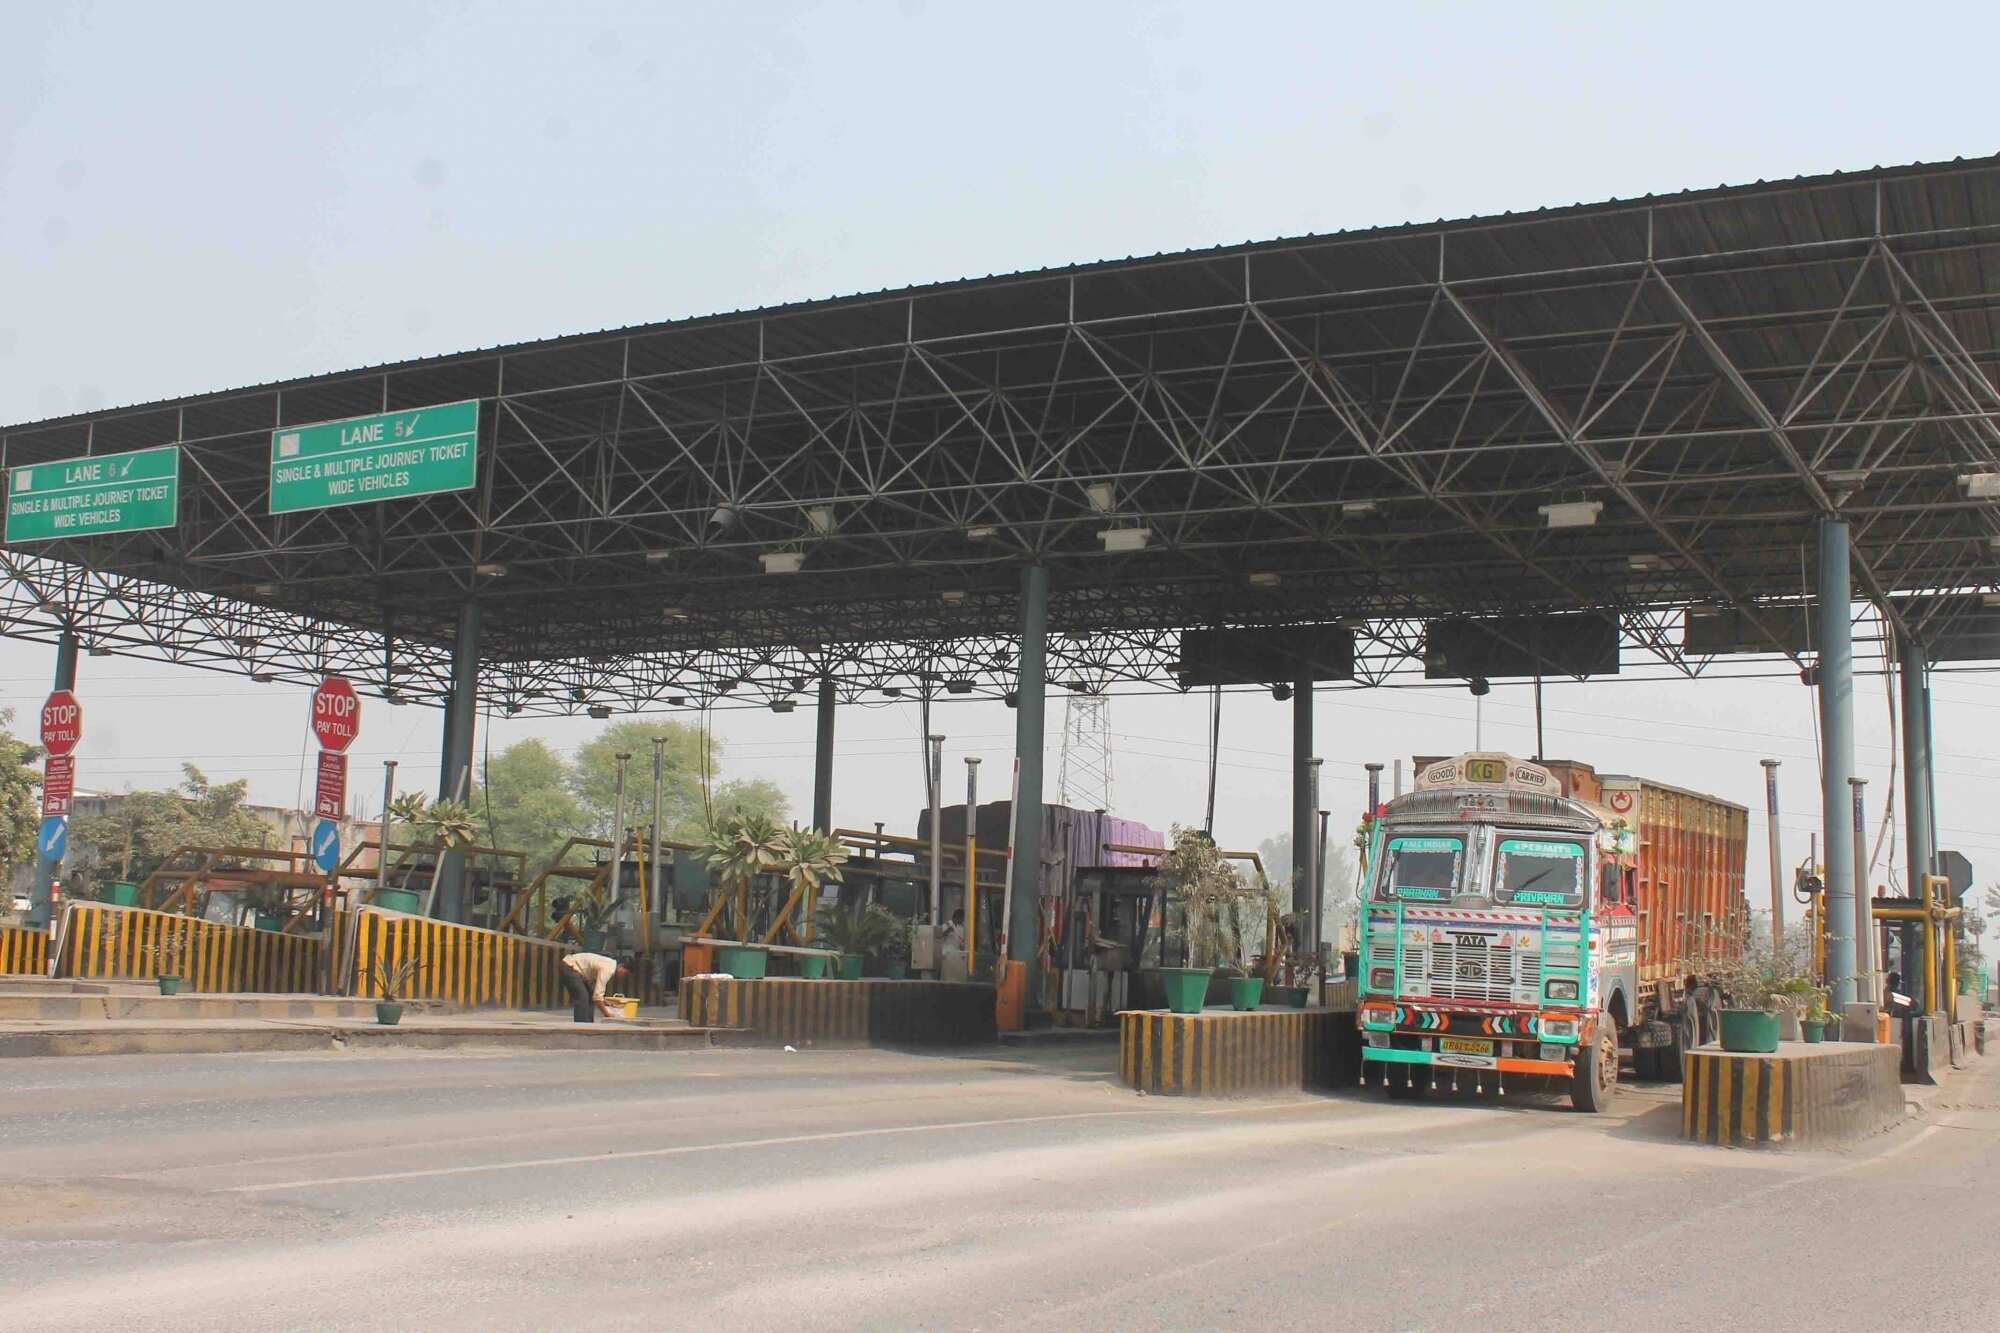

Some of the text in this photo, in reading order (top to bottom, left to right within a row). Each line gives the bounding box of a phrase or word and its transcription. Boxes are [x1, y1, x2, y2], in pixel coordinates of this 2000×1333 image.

[340, 423, 384, 446] LANE
[276, 442, 469, 484] SINGLE & MULTIPLE JOURNEY TICKET
[65, 464, 101, 484] LANE
[328, 471, 410, 496] WIDE VEHICLES
[11, 485, 169, 515] SINGLE & MULTIPLE JOURNEY TICKET
[54, 509, 121, 529] WIDE VEHICLES
[316, 692, 355, 717] STOP
[43, 704, 77, 726] STOP
[44, 729, 75, 743] PAY TOLL
[317, 720, 352, 737] PAY TOLL
[1430, 767, 1454, 781] GOODS
[1471, 762, 1493, 779] KG
[1517, 767, 1545, 784] CARRIER
[1455, 935, 1487, 946] TATA
